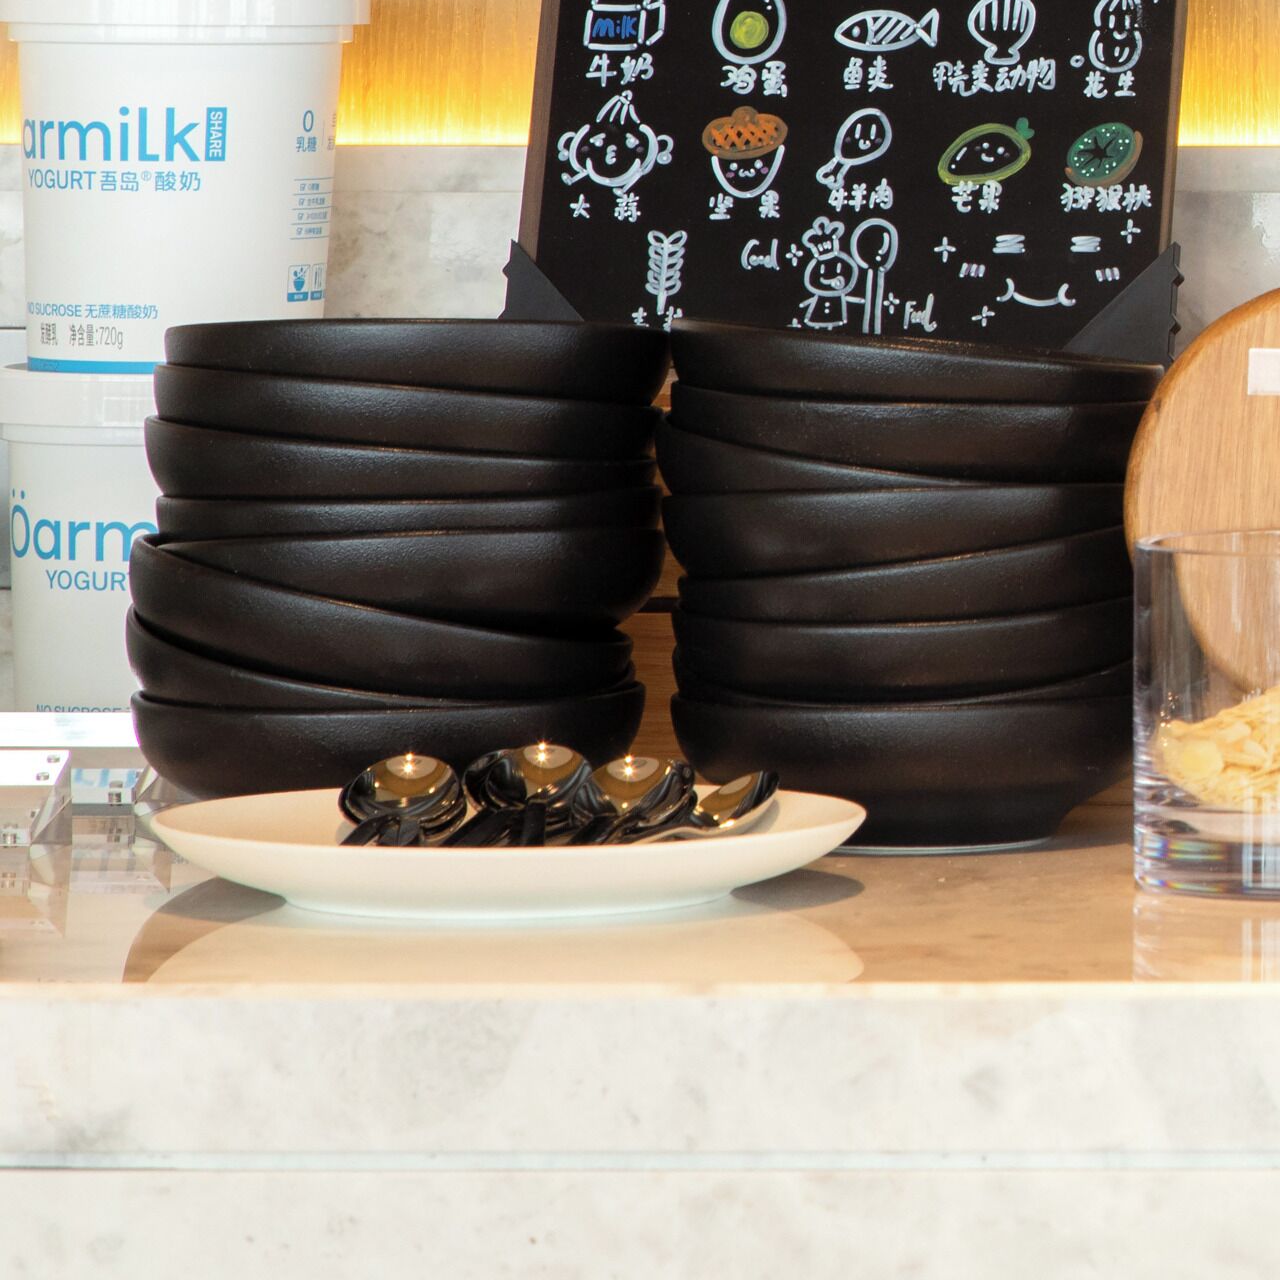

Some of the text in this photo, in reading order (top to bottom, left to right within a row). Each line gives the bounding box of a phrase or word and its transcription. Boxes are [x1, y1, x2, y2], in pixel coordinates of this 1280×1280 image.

[586, 53, 655, 87] 牛奶
[720, 61, 788, 98] 鸡蛋
[841, 55, 894, 93] 鱼类
[932, 56, 1057, 98] 甲壳类动物
[1083, 71, 1137, 99] 花生
[209, 111, 223, 158] SHARE
[29, 168, 96, 190] YOGURT
[828, 178, 894, 212] 牛羊肉
[570, 192, 641, 222] 大蒜
[708, 190, 780, 220] 坚果
[952, 180, 1003, 213] 芒果
[36, 303, 82, 317] SUCROSE
[85, 304, 158, 320] 无蔗糖酸奶
[46, 570, 129, 591] YOGUR
